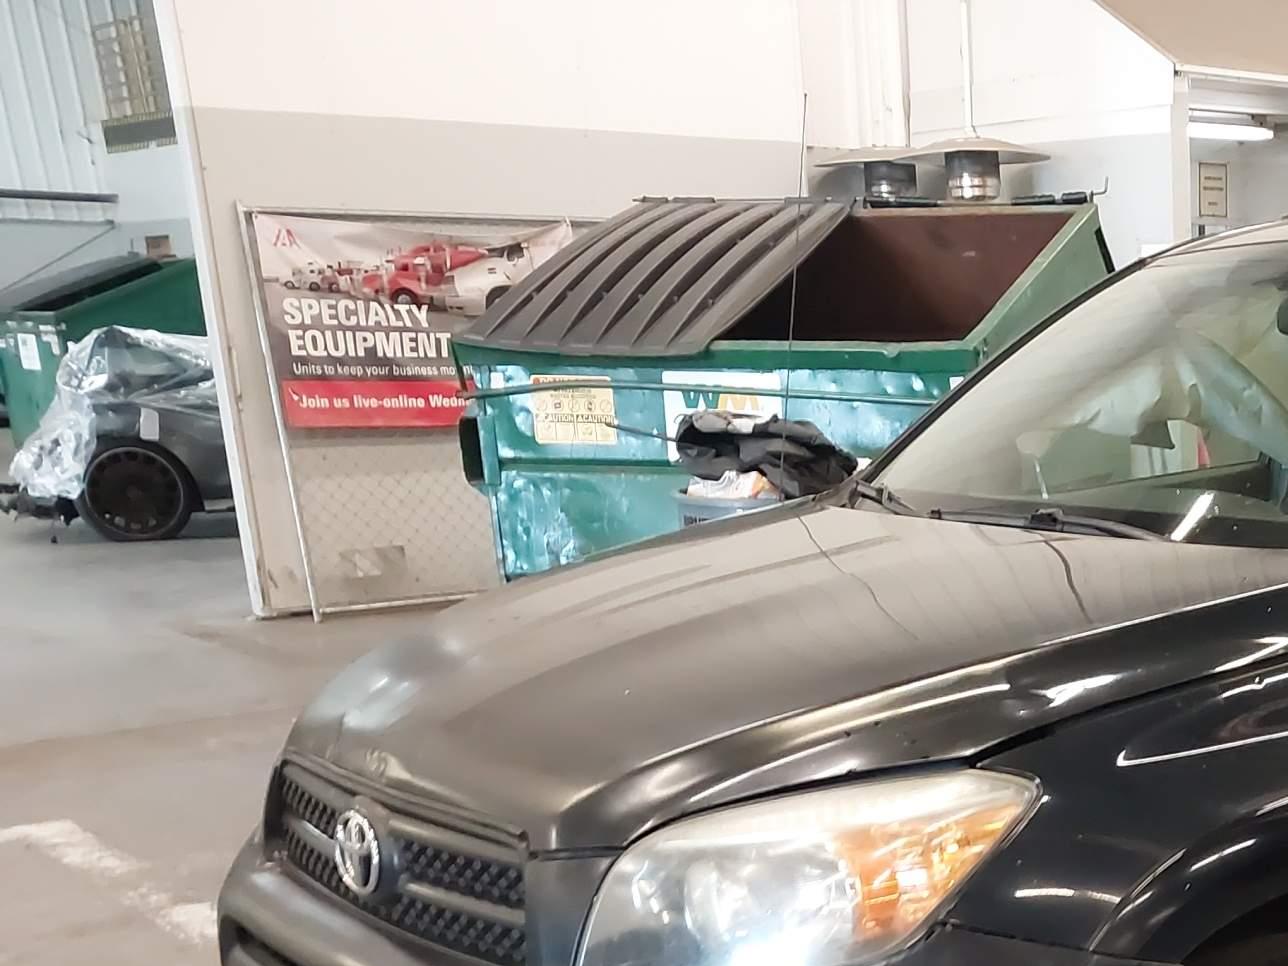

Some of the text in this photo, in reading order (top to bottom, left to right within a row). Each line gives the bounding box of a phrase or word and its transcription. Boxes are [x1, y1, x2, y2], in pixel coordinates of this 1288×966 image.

[282, 297, 429, 328] SPECIALTY
[288, 329, 452, 359] EQUIPMENT
[292, 362, 322, 375] Units
[323, 364, 335, 375] to
[337, 363, 364, 377] keep
[365, 365, 389, 377] your
[392, 364, 439, 376] business
[301, 395, 329, 408] Join
[332, 397, 350, 408] us
[353, 394, 425, 408] live-online
